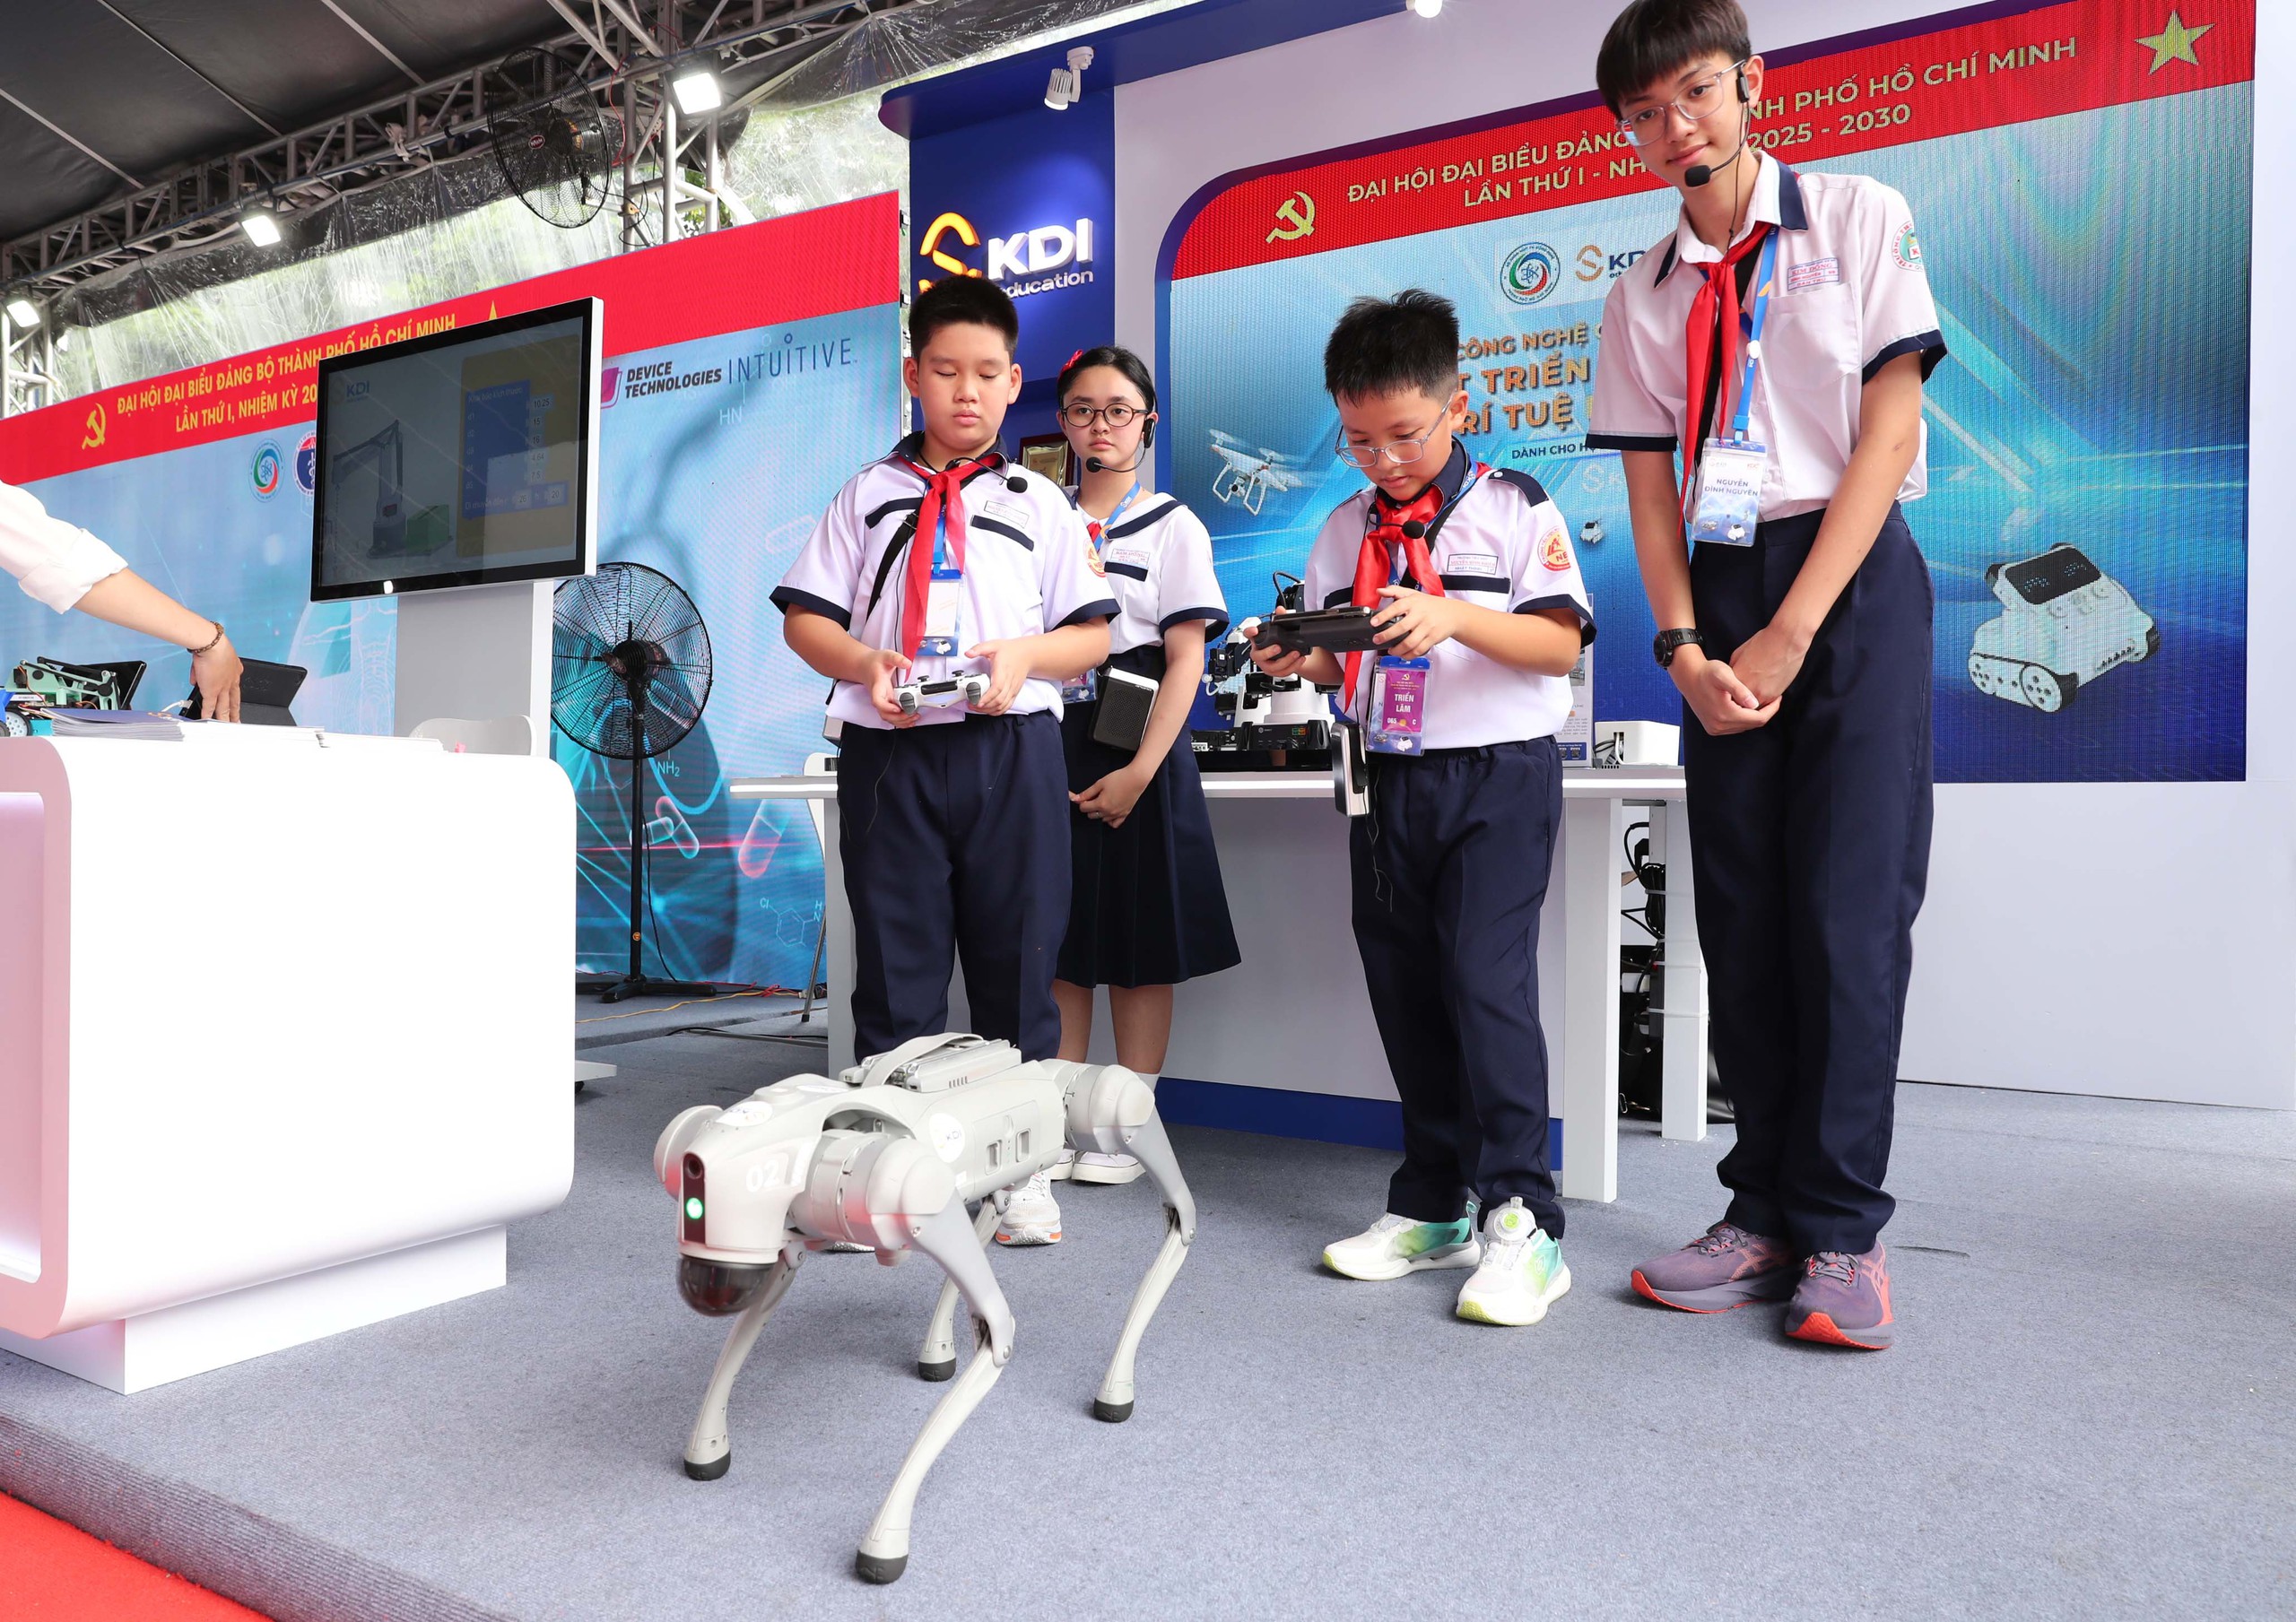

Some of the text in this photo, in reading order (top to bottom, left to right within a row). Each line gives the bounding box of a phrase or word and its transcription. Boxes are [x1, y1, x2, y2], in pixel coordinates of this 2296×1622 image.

[1796, 74, 1858, 112] PHỐ
[1869, 63, 1916, 98] HỒ
[1924, 49, 1980, 86] CHÍ
[1989, 37, 2076, 74] MINH
[1747, 122, 1813, 152] 2025
[1839, 103, 1911, 135] 2030
[1348, 179, 1387, 203] ĐẠI
[1395, 167, 1434, 194] HỘI
[1441, 158, 1483, 184] ĐẠI
[1492, 142, 1548, 174] BIỂU
[1465, 179, 1511, 207] LẦN
[1518, 167, 1571, 196] THỨ
[1578, 167, 1584, 186] I
[987, 218, 1093, 282] KDI
[1001, 269, 1094, 299] ducation
[1522, 321, 1589, 351] NGHỆ
[117, 394, 137, 417] ĐẠI
[140, 385, 161, 412] HỘI
[164, 383, 184, 406] ĐẠI
[187, 368, 213, 398] BIỂU
[216, 364, 252, 391] ĐẢNG
[257, 355, 274, 384] BỘ
[278, 349, 322, 376] THÀNH
[417, 313, 456, 339] MINH
[626, 360, 673, 383] DEVICE
[1481, 351, 1590, 395] TRIỂN
[346, 380, 370, 398] KDI
[625, 368, 722, 399] TECHNOLOGIES
[176, 404, 198, 433] LẦN
[202, 400, 226, 427] THỨ
[227, 403, 235, 424] I,
[239, 390, 277, 419] NHIỆM
[282, 383, 298, 408] KỲ
[719, 407, 743, 426] HN
[1502, 392, 1573, 431] TUỆ
[1512, 446, 1546, 460] DÀNH
[1550, 442, 1577, 455] CHO
[1395, 692, 1414, 702] TRIỂN
[746, 1160, 779, 1193] 02
